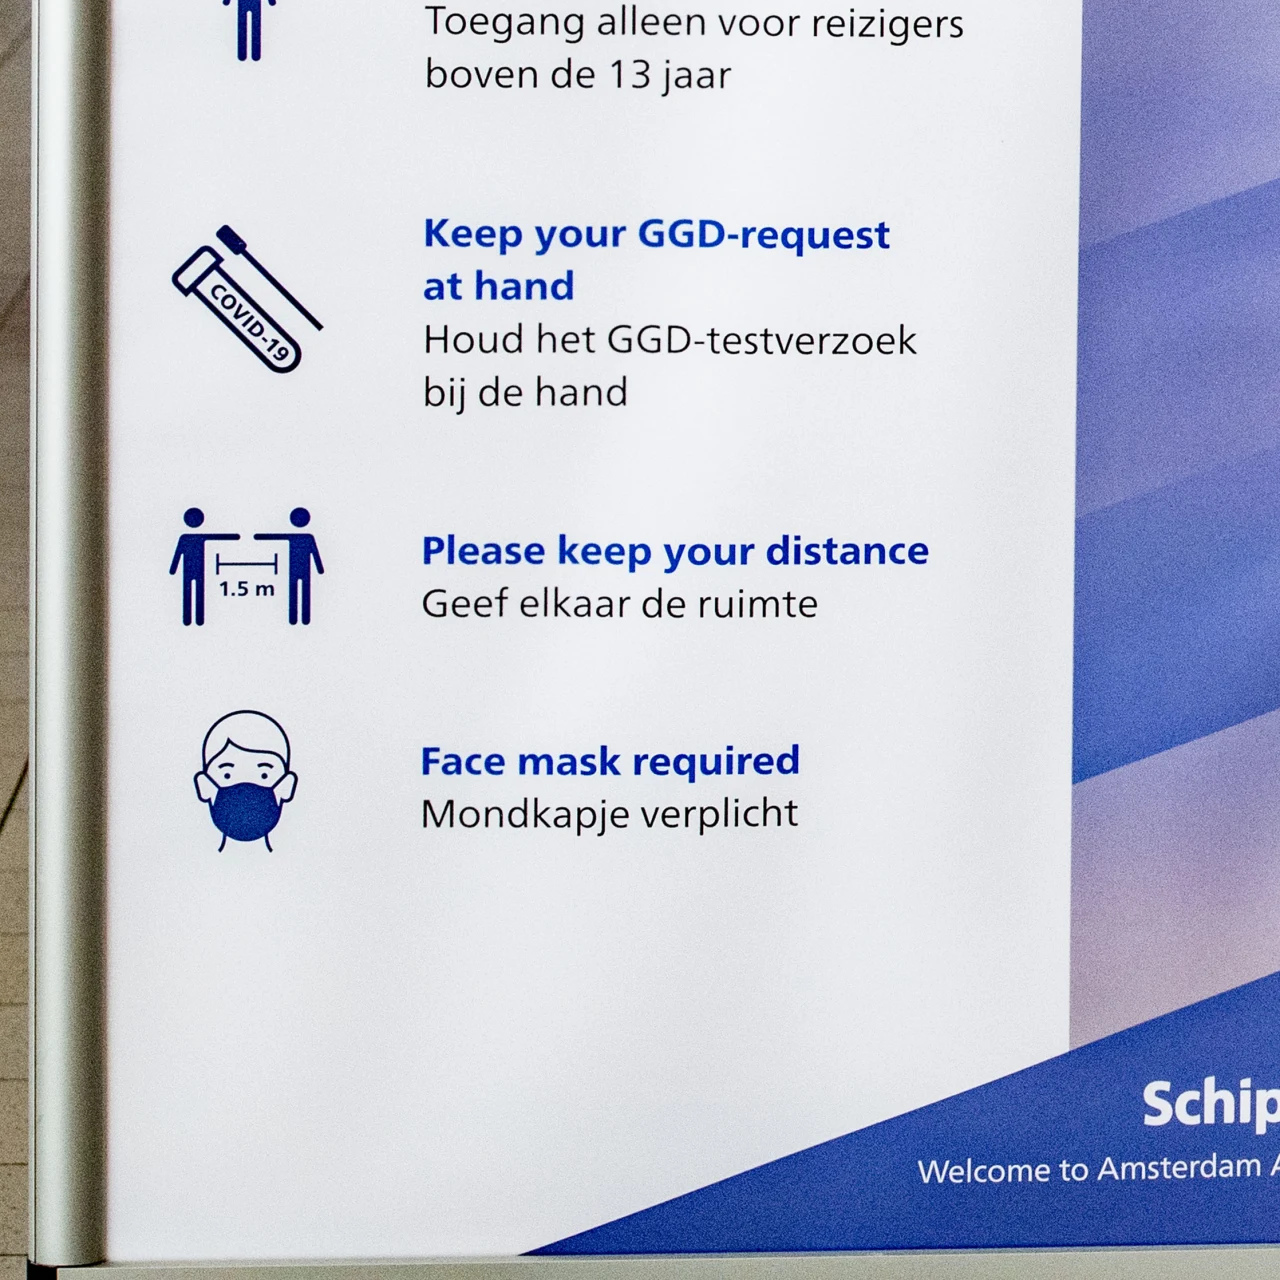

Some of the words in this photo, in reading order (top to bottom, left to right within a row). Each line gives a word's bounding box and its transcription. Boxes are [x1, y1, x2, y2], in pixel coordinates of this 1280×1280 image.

[424, 5, 584, 45] Toegang
[597, 3, 706, 36] alleen
[718, 14, 801, 37] voor
[813, 7, 964, 47] reizigers
[426, 56, 538, 89] boven
[551, 56, 596, 89] de
[611, 58, 650, 89] 13
[661, 59, 732, 98] jaar
[424, 218, 523, 256] Keep
[534, 225, 627, 257] your
[638, 218, 891, 258] GGD-request
[423, 272, 463, 301] at
[475, 268, 574, 301] hand
[210, 283, 290, 362] COVID-19
[425, 322, 523, 354] Houd
[537, 322, 596, 354] het
[607, 323, 917, 356] GGD-testverzoek
[424, 375, 466, 416] bij
[478, 375, 523, 407] de
[536, 375, 627, 407] hand
[423, 533, 546, 566] Please
[558, 533, 652, 574] keep
[663, 543, 756, 575] your
[766, 533, 930, 566] distance
[219, 580, 249, 597] 1.5
[255, 584, 275, 597] m
[422, 586, 509, 619] Geef
[519, 586, 631, 618] elkaar
[641, 586, 686, 619] de
[699, 588, 818, 619] ruimte
[421, 746, 506, 776] Face
[518, 744, 622, 777] mask
[633, 743, 800, 784] required
[422, 796, 630, 837] Mondkapje
[640, 795, 799, 837] verplicht
[917, 1157, 1051, 1184] Welcome
[1059, 1159, 1089, 1182] to
[1097, 1152, 1261, 1181] Amsterdam
